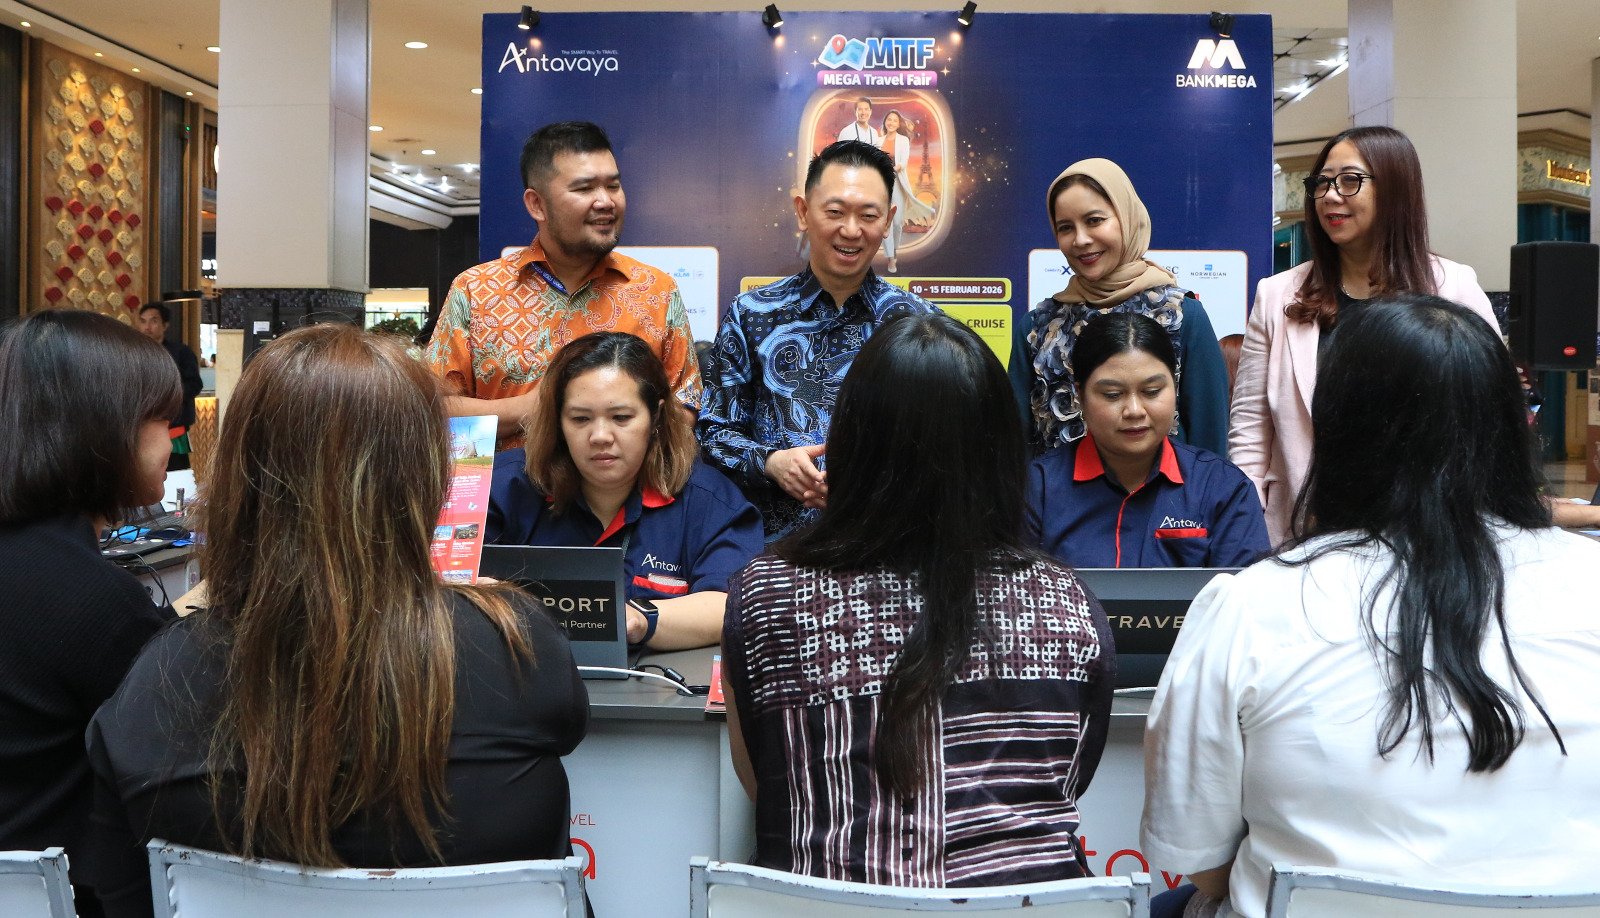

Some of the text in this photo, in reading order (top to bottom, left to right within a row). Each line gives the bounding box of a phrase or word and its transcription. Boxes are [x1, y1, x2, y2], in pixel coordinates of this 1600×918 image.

[864, 37, 936, 69] MTF
[498, 42, 619, 76] Antavaya
[823, 72, 932, 86] MEGA Travel Fair
[912, 285, 922, 294] 10
[930, 285, 939, 294] 15
[940, 285, 980, 294] FEBRUARI
[982, 285, 1003, 294] 2026
[967, 319, 1005, 328] CRUISE
[570, 620, 607, 629] Partner
